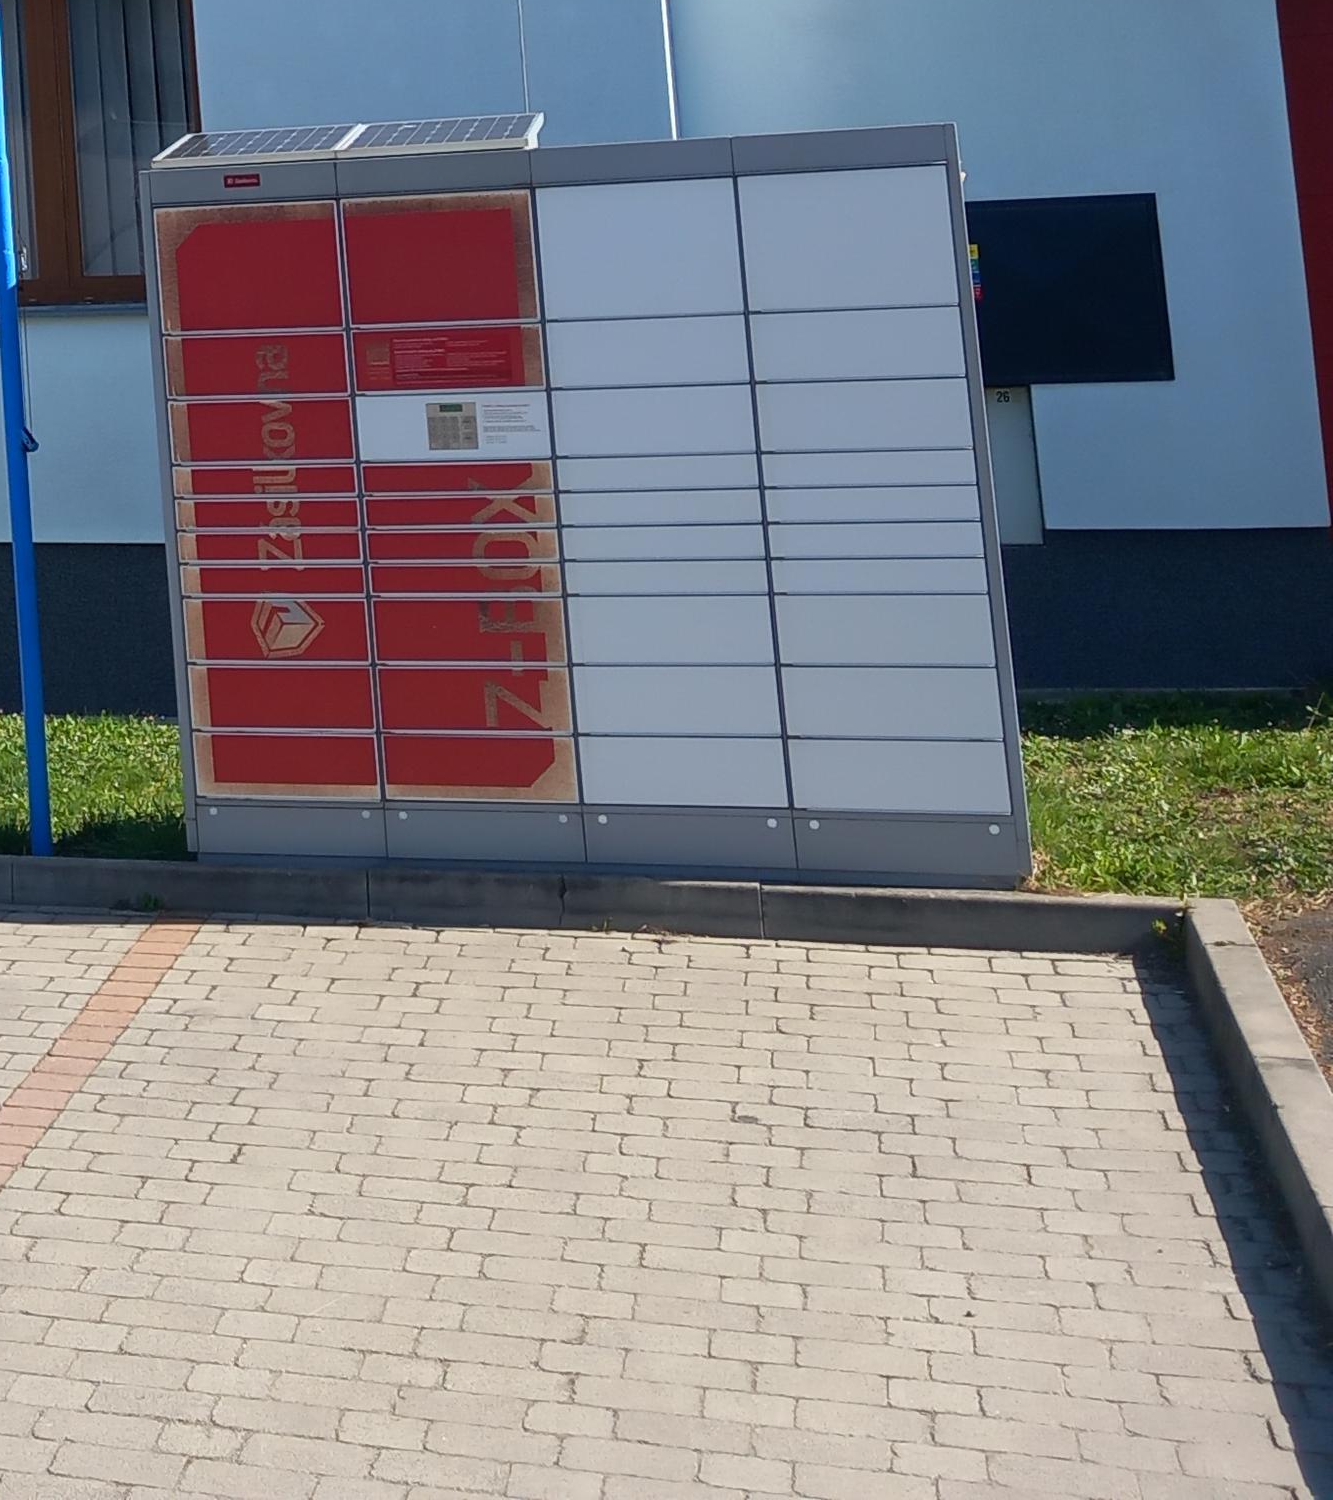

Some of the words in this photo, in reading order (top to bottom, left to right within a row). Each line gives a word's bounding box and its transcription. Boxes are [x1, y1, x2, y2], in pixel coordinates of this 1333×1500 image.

[252, 344, 305, 571] Zásilkovna
[996, 390, 1010, 403] 26
[468, 476, 554, 730] Z-BOX
